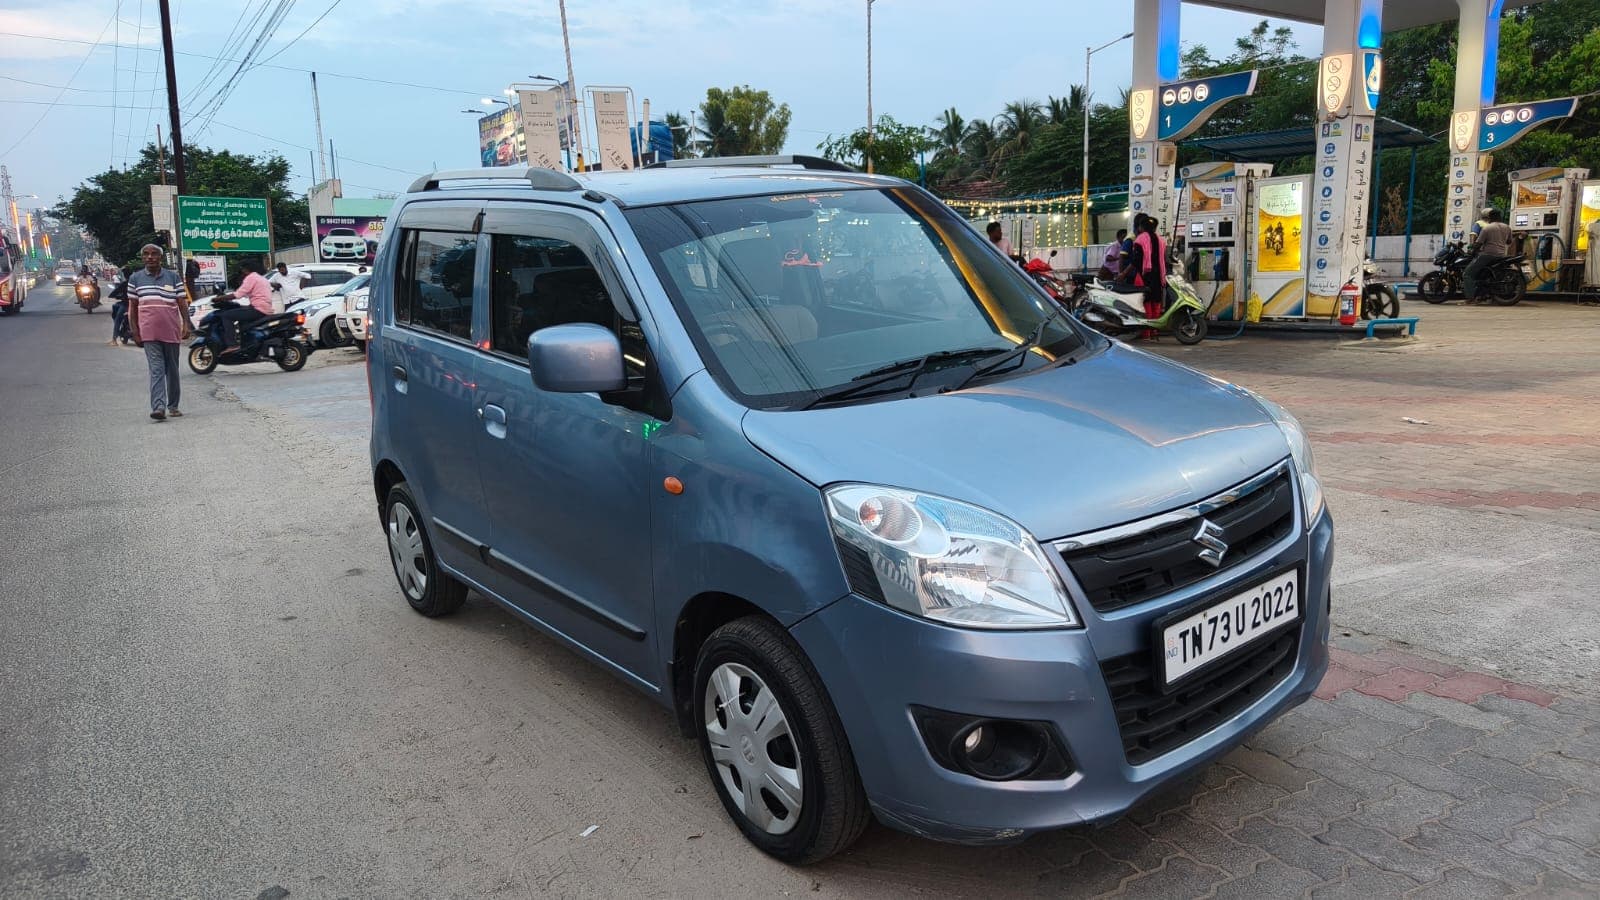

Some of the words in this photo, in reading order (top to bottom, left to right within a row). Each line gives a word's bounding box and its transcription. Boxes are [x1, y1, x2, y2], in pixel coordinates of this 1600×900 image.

[1165, 115, 1171, 128] 1
[1486, 132, 1494, 143] 3
[1178, 622, 1203, 664] TN
[1208, 611, 1231, 651] 73
[1235, 602, 1246, 636] U
[1251, 581, 1295, 630] 2022
